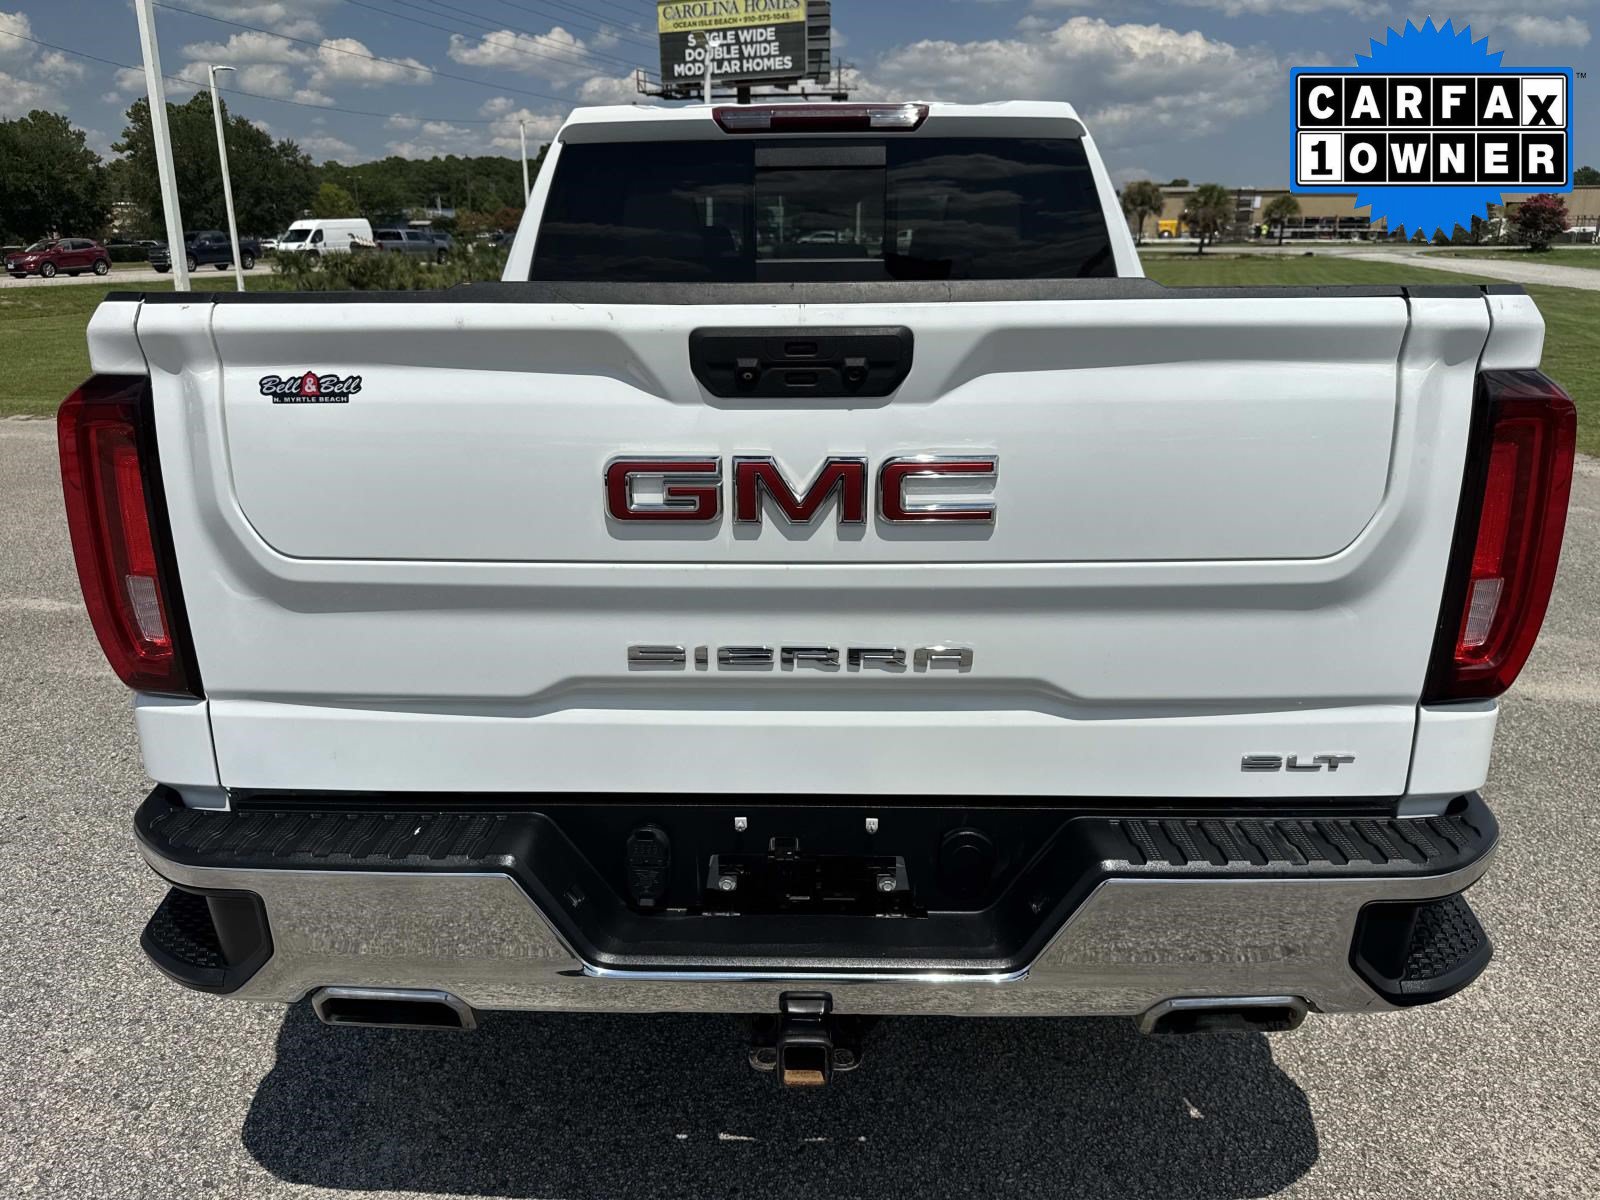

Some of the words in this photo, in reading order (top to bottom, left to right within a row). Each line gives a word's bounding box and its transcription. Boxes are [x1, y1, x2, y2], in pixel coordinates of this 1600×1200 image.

[662, 1, 739, 20] CAROLINA
[744, 0, 800, 13] HOMES
[673, 20, 697, 29] OCEAN
[698, 18, 712, 27] ISLE
[714, 16, 738, 26] BEACH
[738, 27, 776, 43] WIDE
[741, 41, 780, 58] WIDE
[743, 56, 793, 72] HOMES
[260, 377, 302, 394] Bell
[304, 377, 317, 393] &
[319, 376, 362, 394] Bell
[604, 455, 999, 525] GMC
[627, 645, 974, 673] SIERRA
[1240, 755, 1356, 772] SLT
